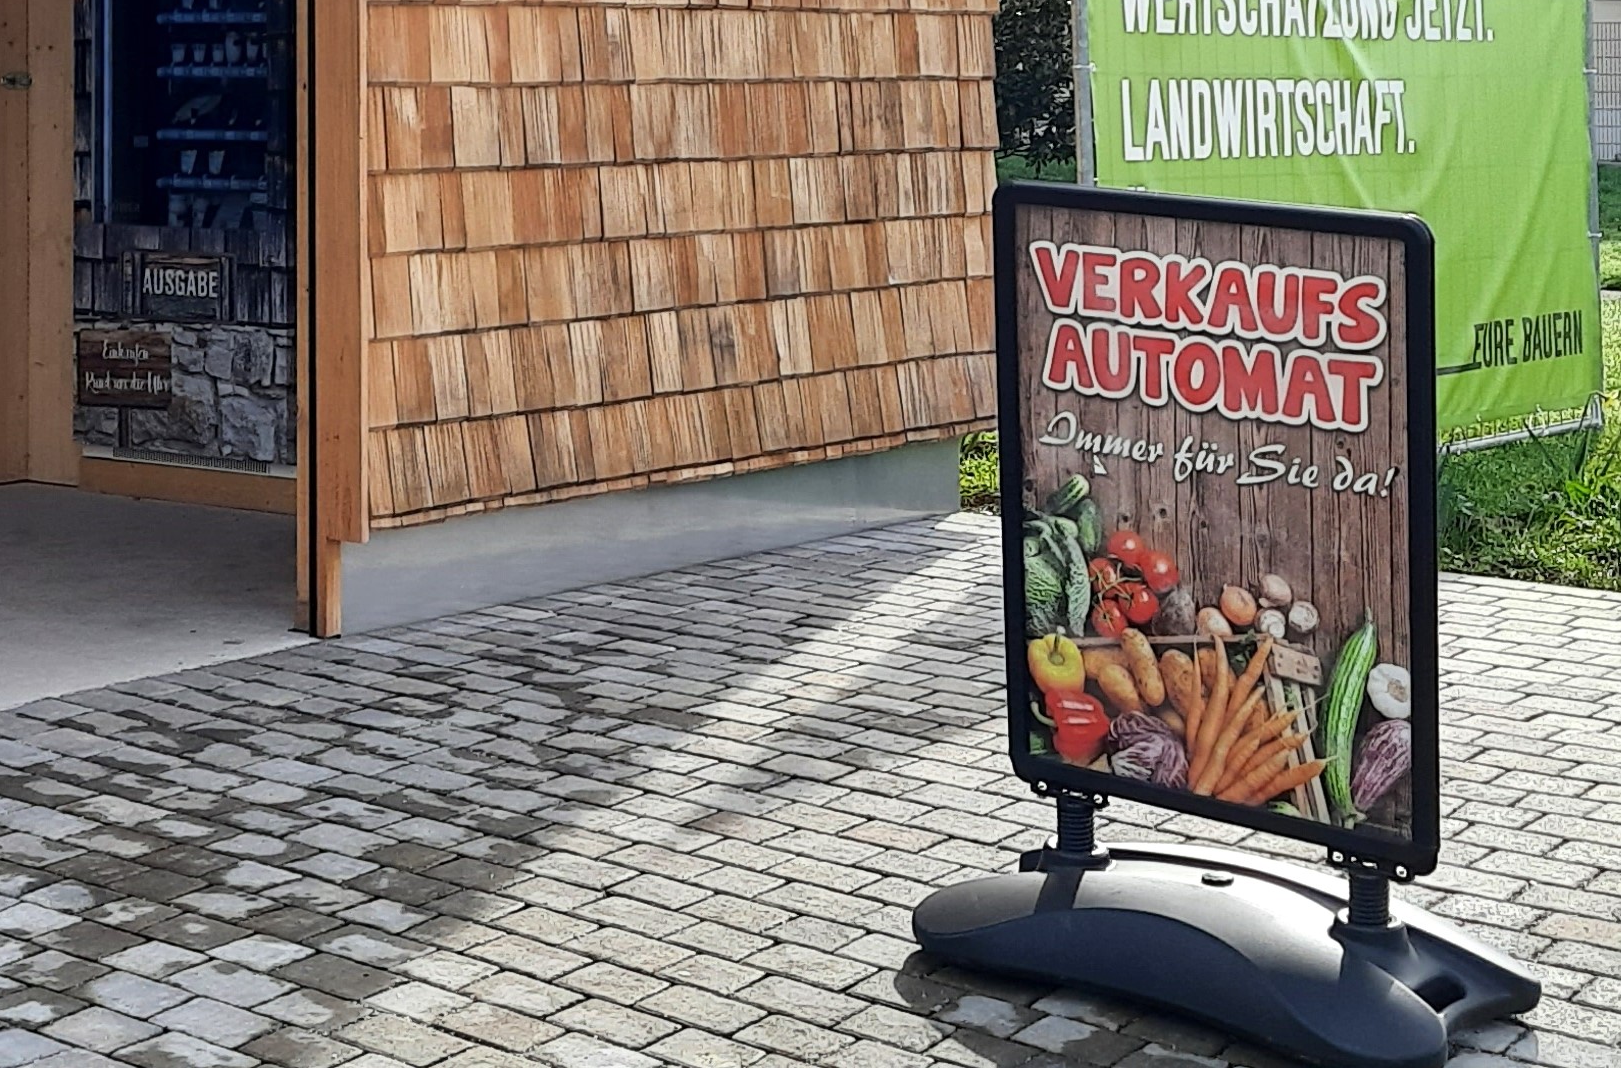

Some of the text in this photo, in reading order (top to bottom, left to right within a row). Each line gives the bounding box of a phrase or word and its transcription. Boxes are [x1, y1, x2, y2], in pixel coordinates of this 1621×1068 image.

[1121, 78, 1416, 162] LANDWIRTSCHAFT.
[142, 267, 218, 298] AUSGABE
[1031, 242, 1385, 349] VERKAUFS
[1044, 320, 1381, 431] AUTOMAT
[1522, 310, 1584, 363] BAUERN
[85, 370, 111, 394] Rund
[1039, 411, 1396, 499] Immer für Sie da!
